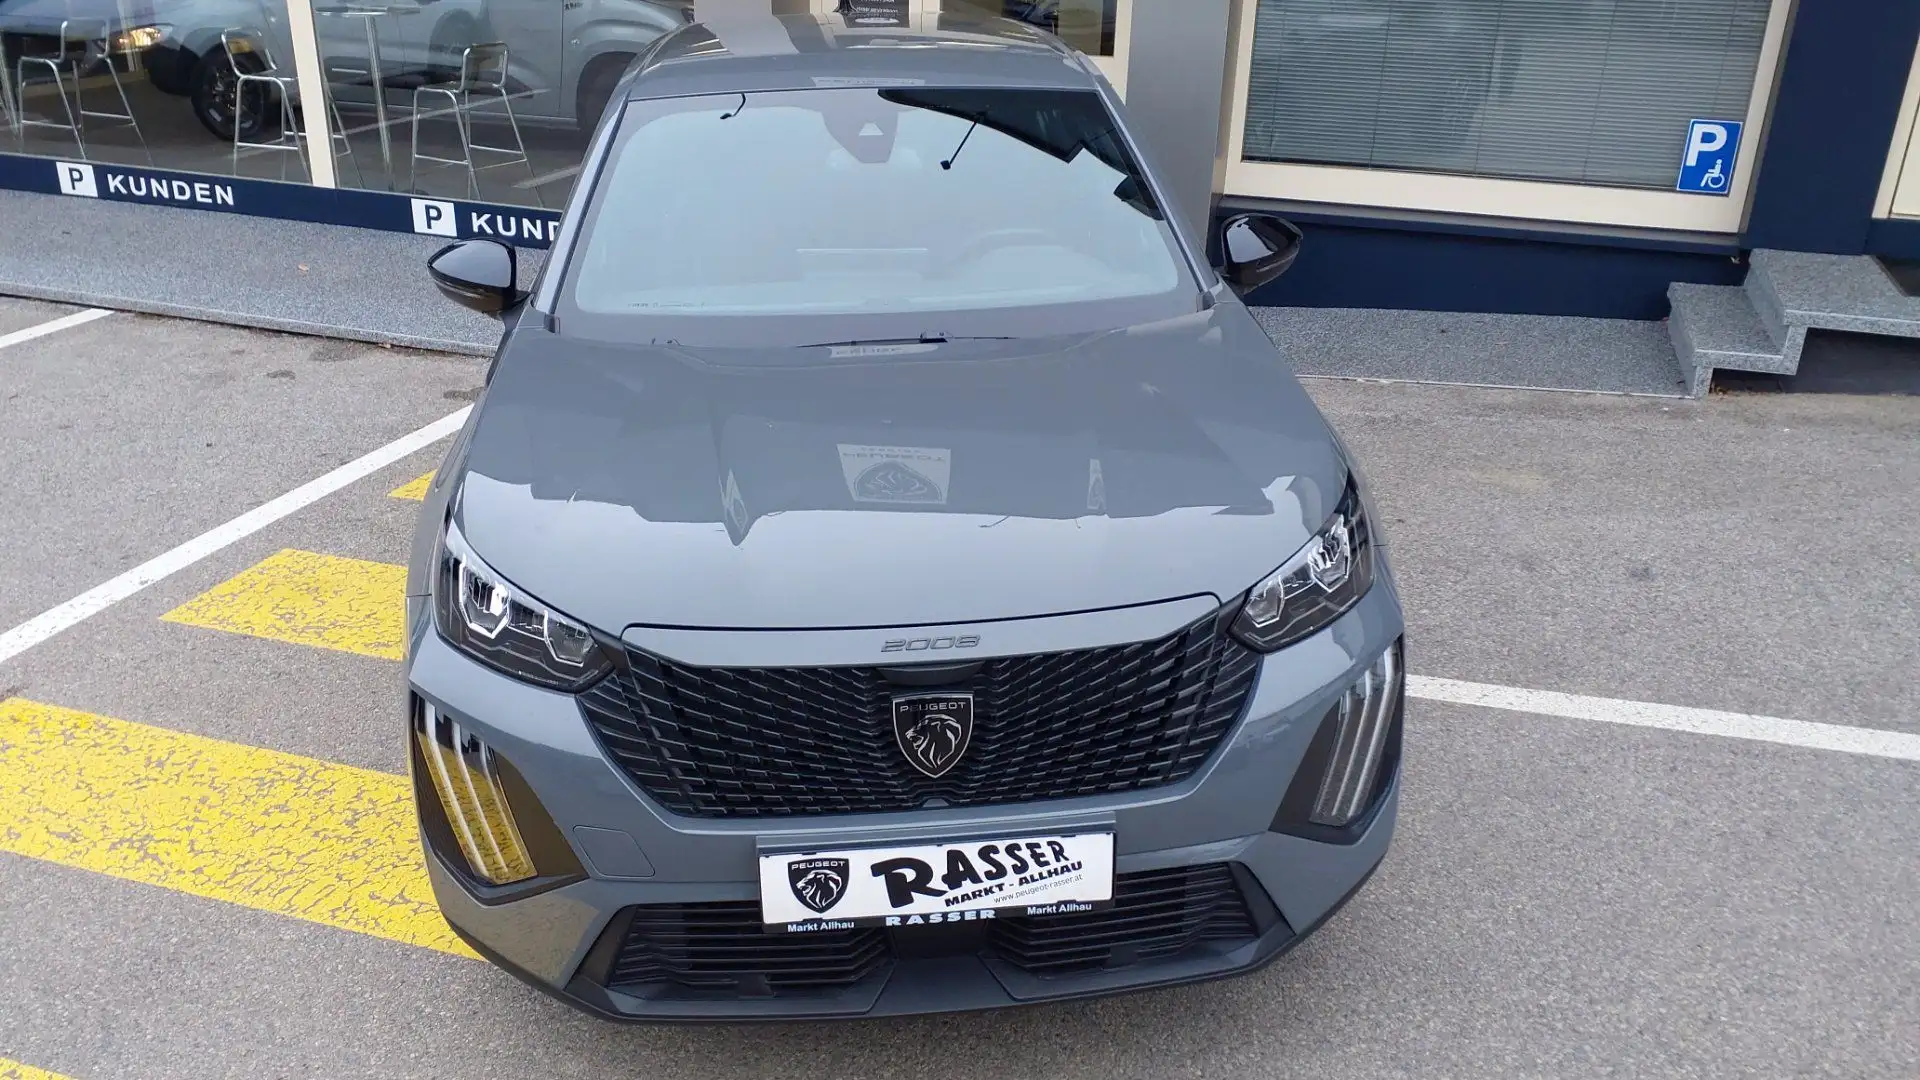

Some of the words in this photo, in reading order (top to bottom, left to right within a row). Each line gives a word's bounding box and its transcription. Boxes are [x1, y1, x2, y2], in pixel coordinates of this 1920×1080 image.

[1685, 123, 1728, 167] P
[68, 167, 84, 191] P
[107, 173, 235, 206] KUNDEN
[424, 204, 443, 230] P
[880, 635, 981, 653] 2008
[900, 701, 966, 712] PEUGEOT
[791, 860, 846, 870] PEUGEOT
[870, 840, 1070, 909] RASSER
[944, 882, 1005, 907] MARKT
[1018, 860, 1083, 887] ALLHAU
[885, 908, 996, 927] RASSER
[1027, 905, 1057, 915] Markt
[1059, 902, 1092, 913] Allhau
[787, 923, 818, 933] Markt
[819, 921, 855, 931] Allhau
